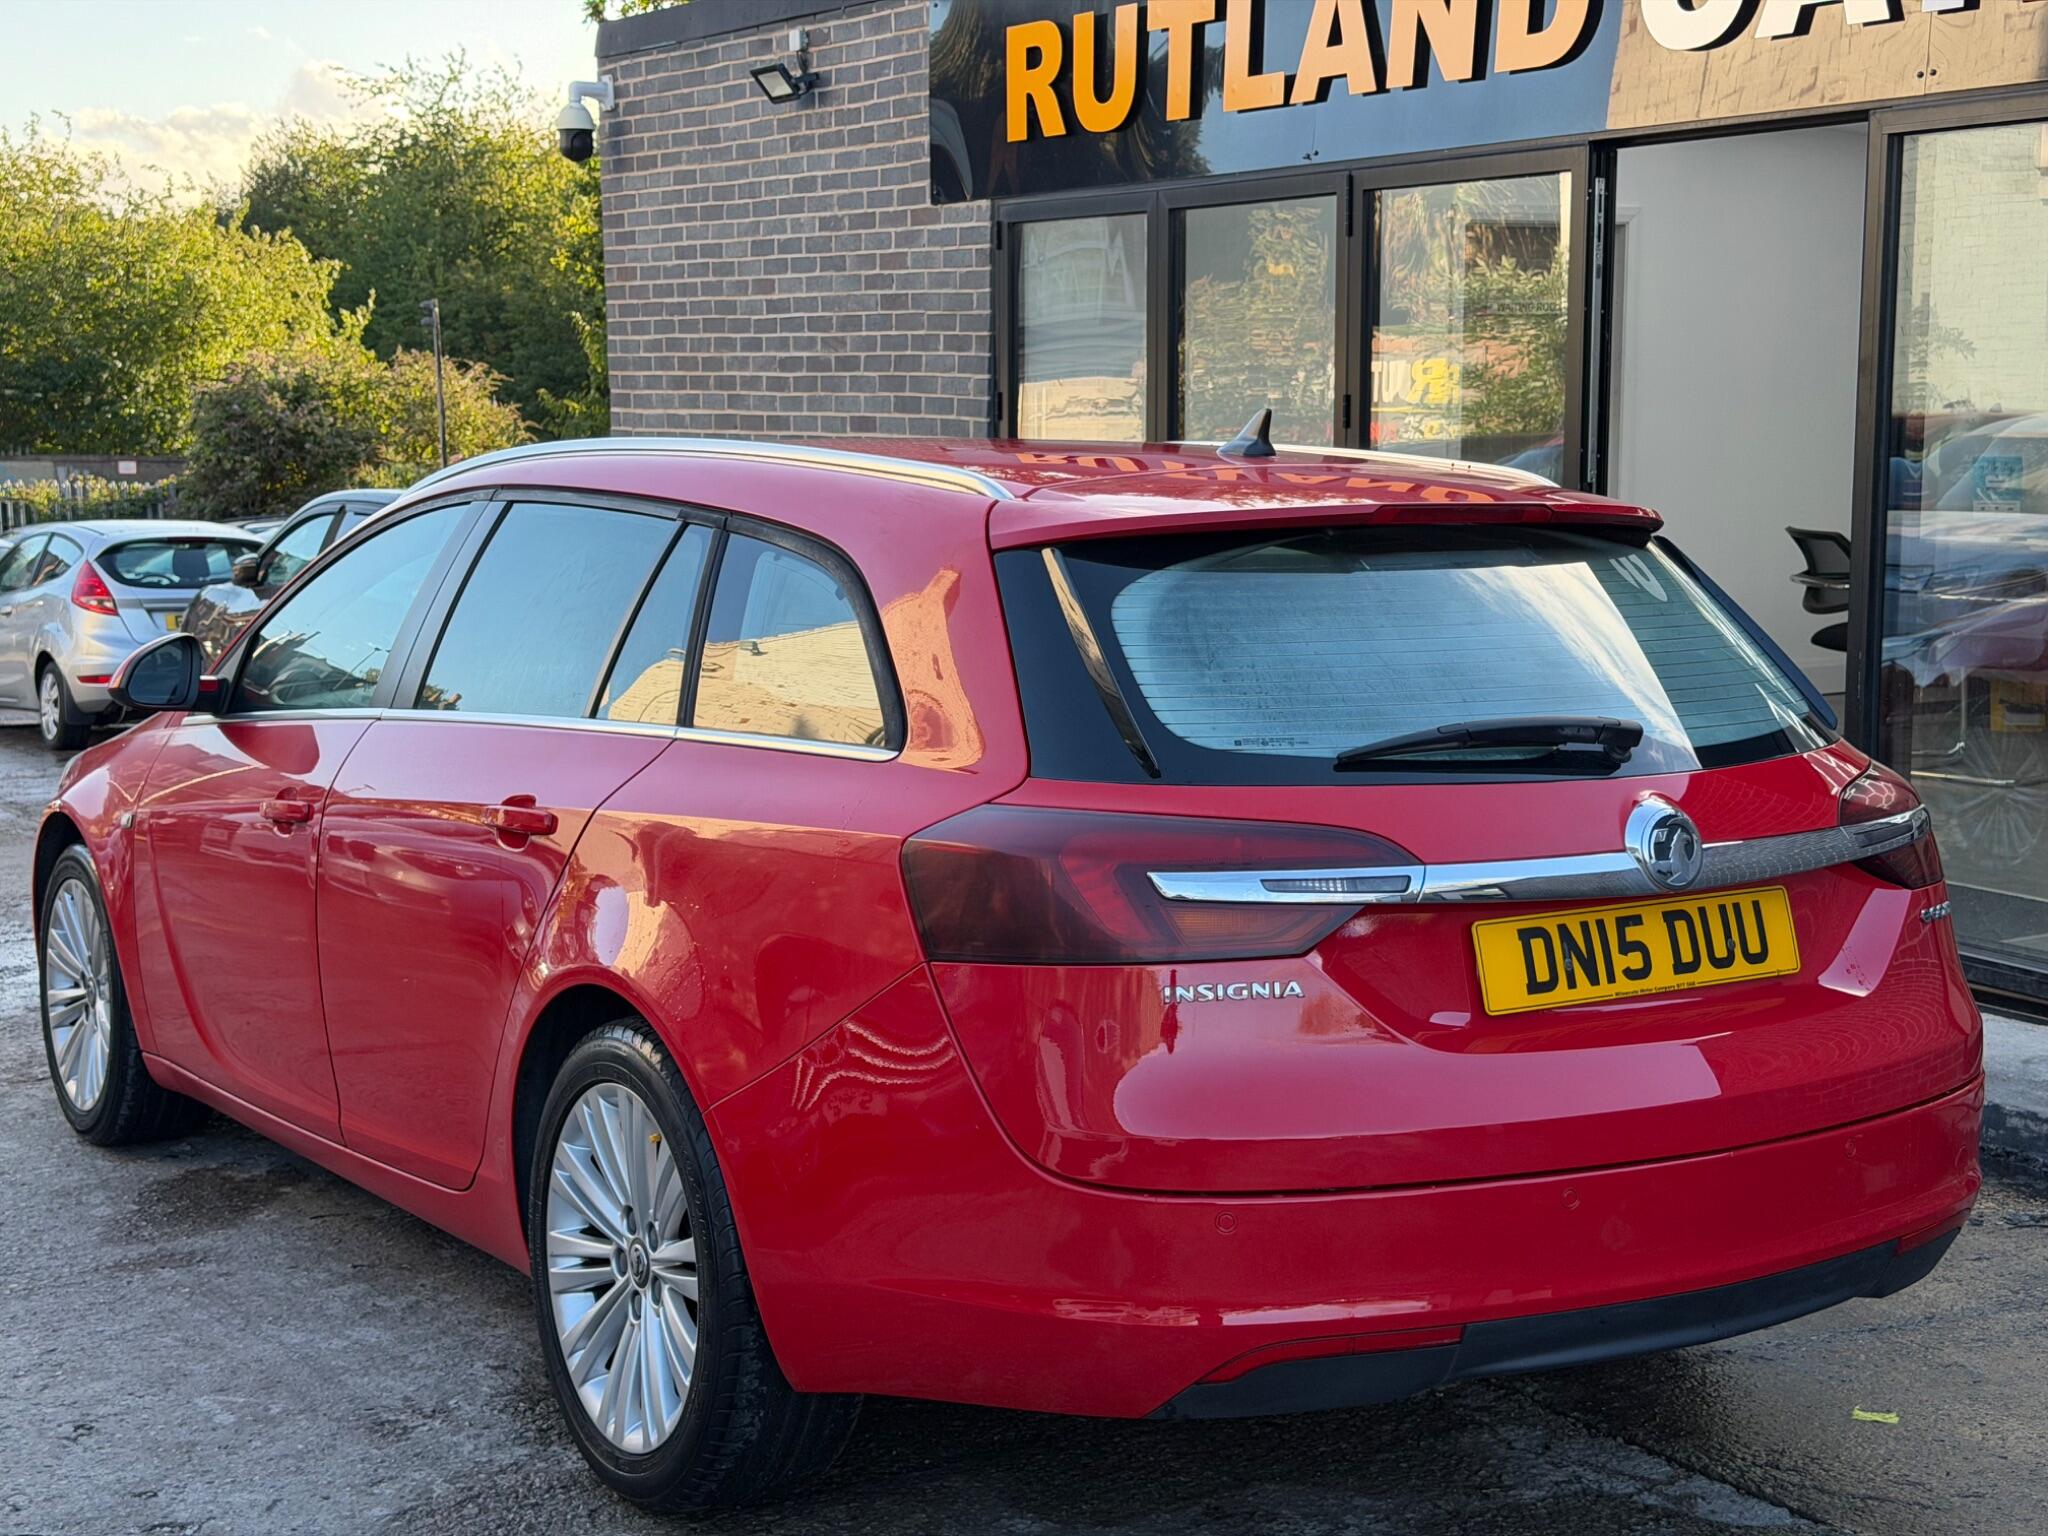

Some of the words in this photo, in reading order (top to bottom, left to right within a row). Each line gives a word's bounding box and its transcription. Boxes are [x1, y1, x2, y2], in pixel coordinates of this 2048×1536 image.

[1005, 0, 1594, 143] RUTLAND
[1163, 980, 1305, 1005] INSIGNIA
[1516, 914, 1653, 996] DN15
[1661, 899, 1770, 976] DUU
